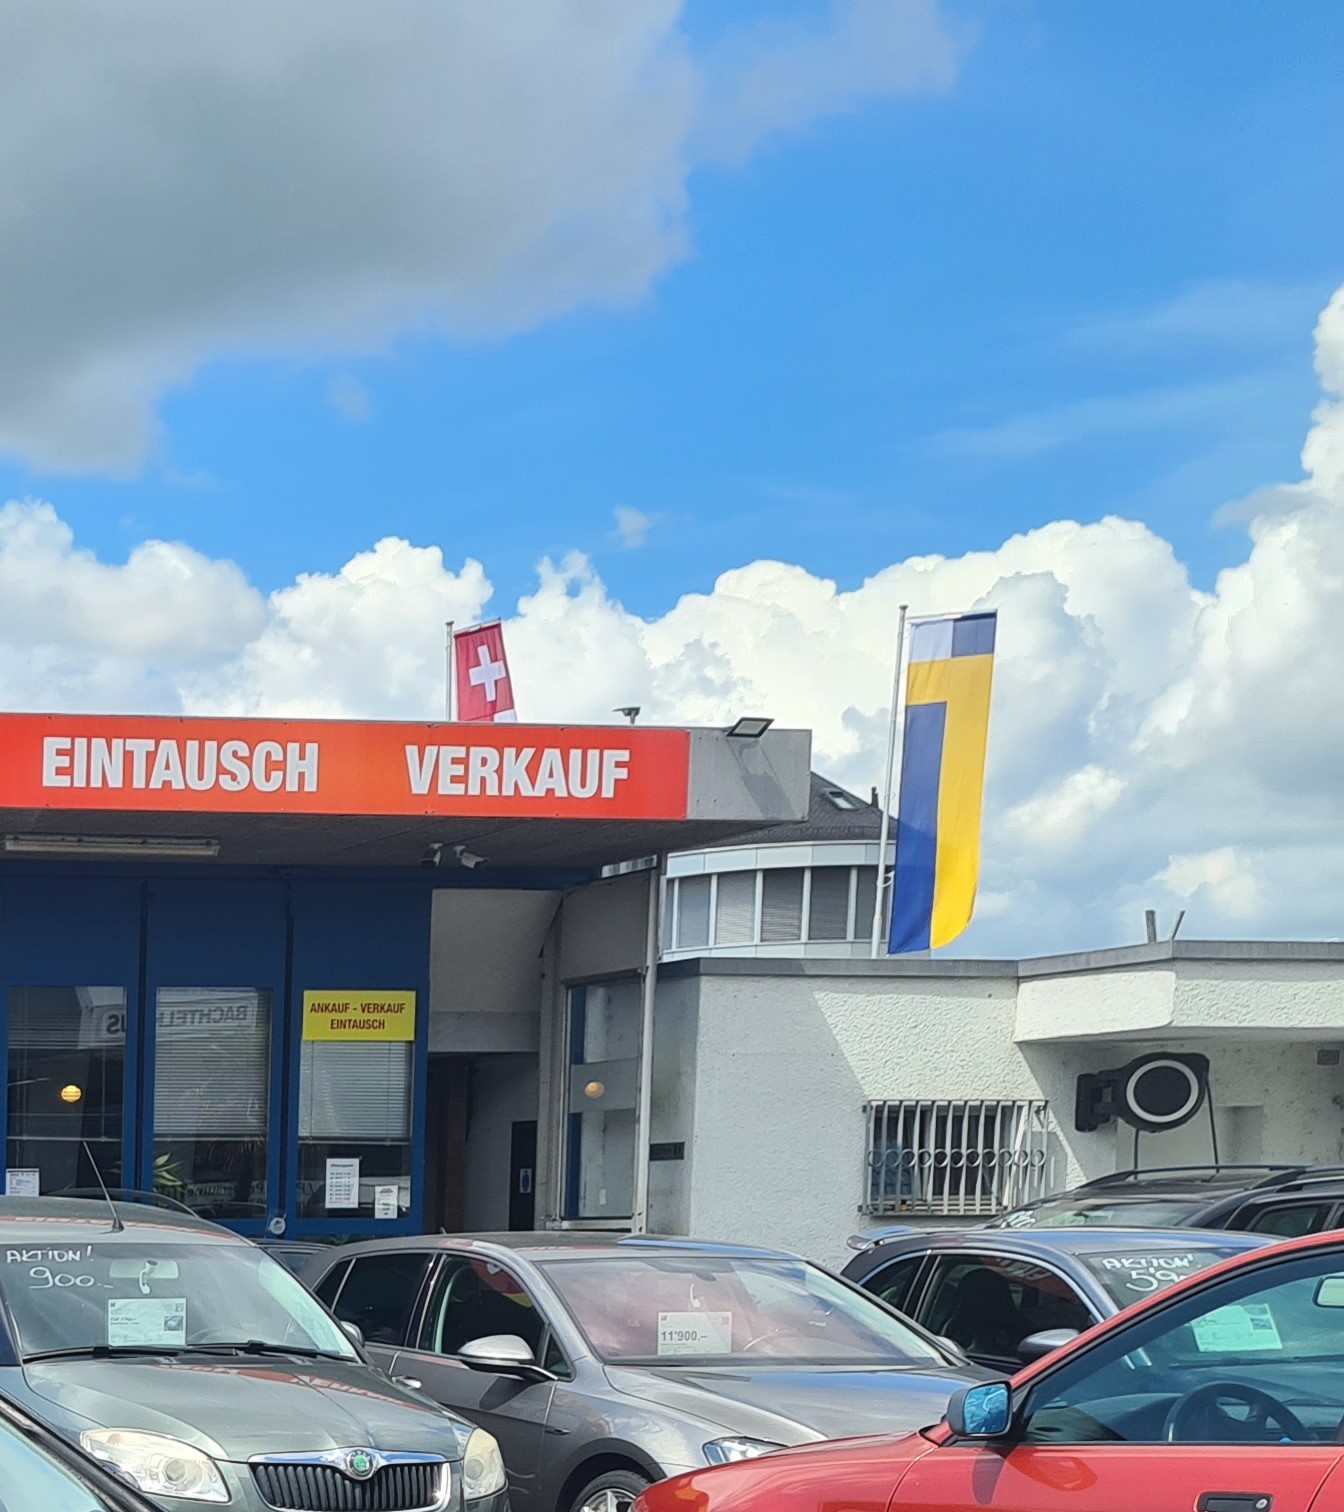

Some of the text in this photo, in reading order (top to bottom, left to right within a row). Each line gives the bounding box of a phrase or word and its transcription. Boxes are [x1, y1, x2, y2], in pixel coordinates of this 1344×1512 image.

[42, 737, 319, 792] EINTAUSCH
[405, 745, 630, 798] VERKAUF
[310, 1003, 350, 1014] ANKAUF
[360, 1003, 405, 1014] VERKAUF
[330, 1019, 385, 1030] EINTAUSCH
